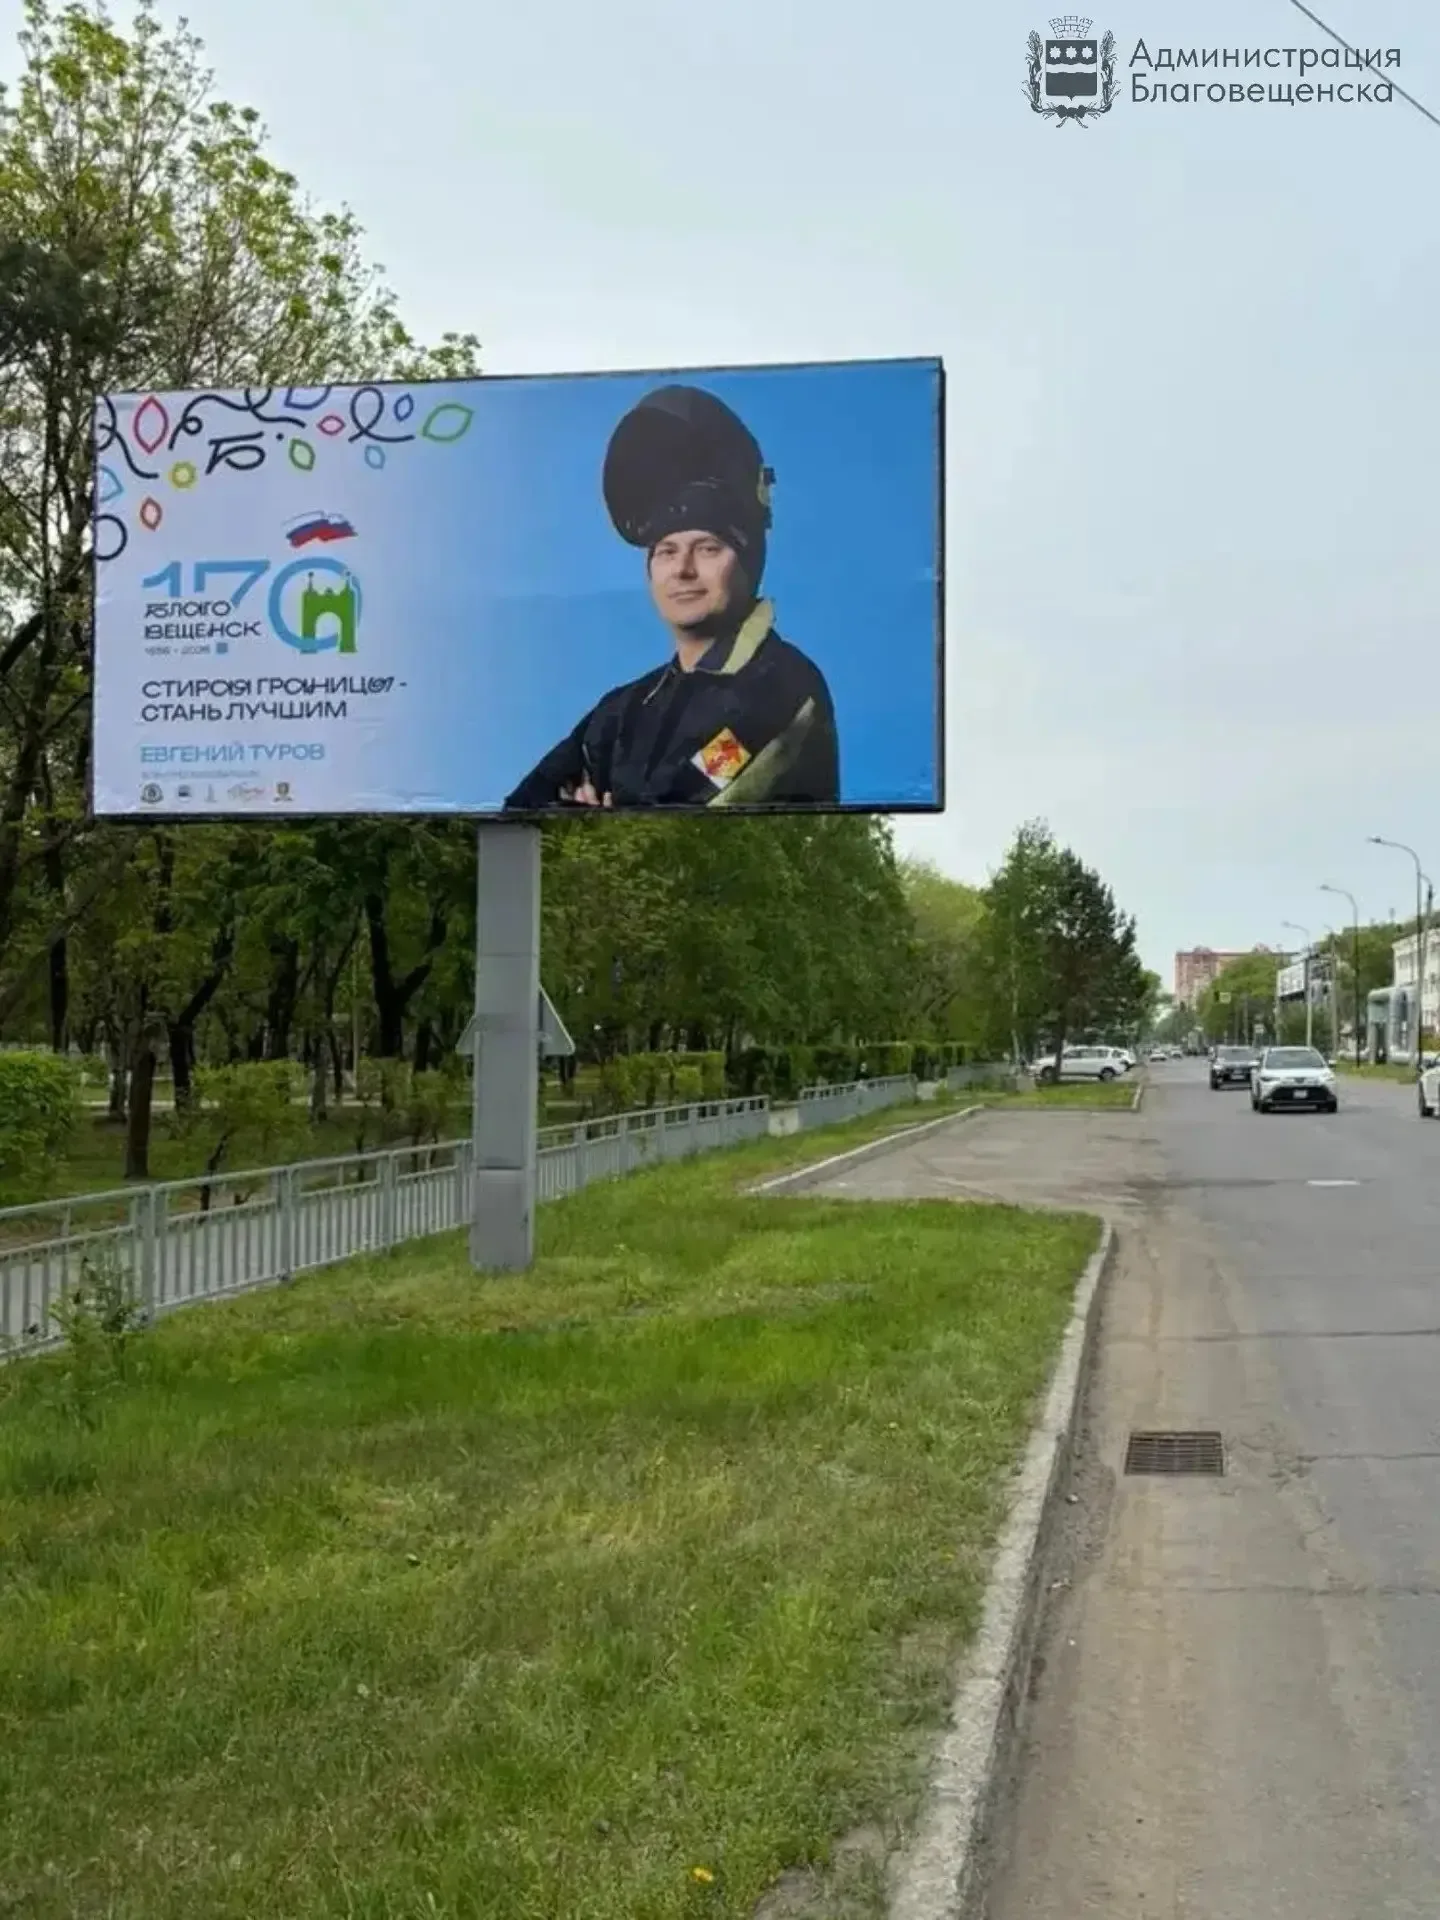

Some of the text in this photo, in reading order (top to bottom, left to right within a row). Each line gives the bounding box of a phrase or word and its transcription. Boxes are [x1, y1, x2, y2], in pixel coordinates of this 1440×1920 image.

[144, 620, 262, 640] ВЕЩЕНСК
[141, 700, 348, 722] СТАНЬ ЛУЧШИМ
[140, 741, 325, 763] ЕВГЕНИЙ ТУРОВ
